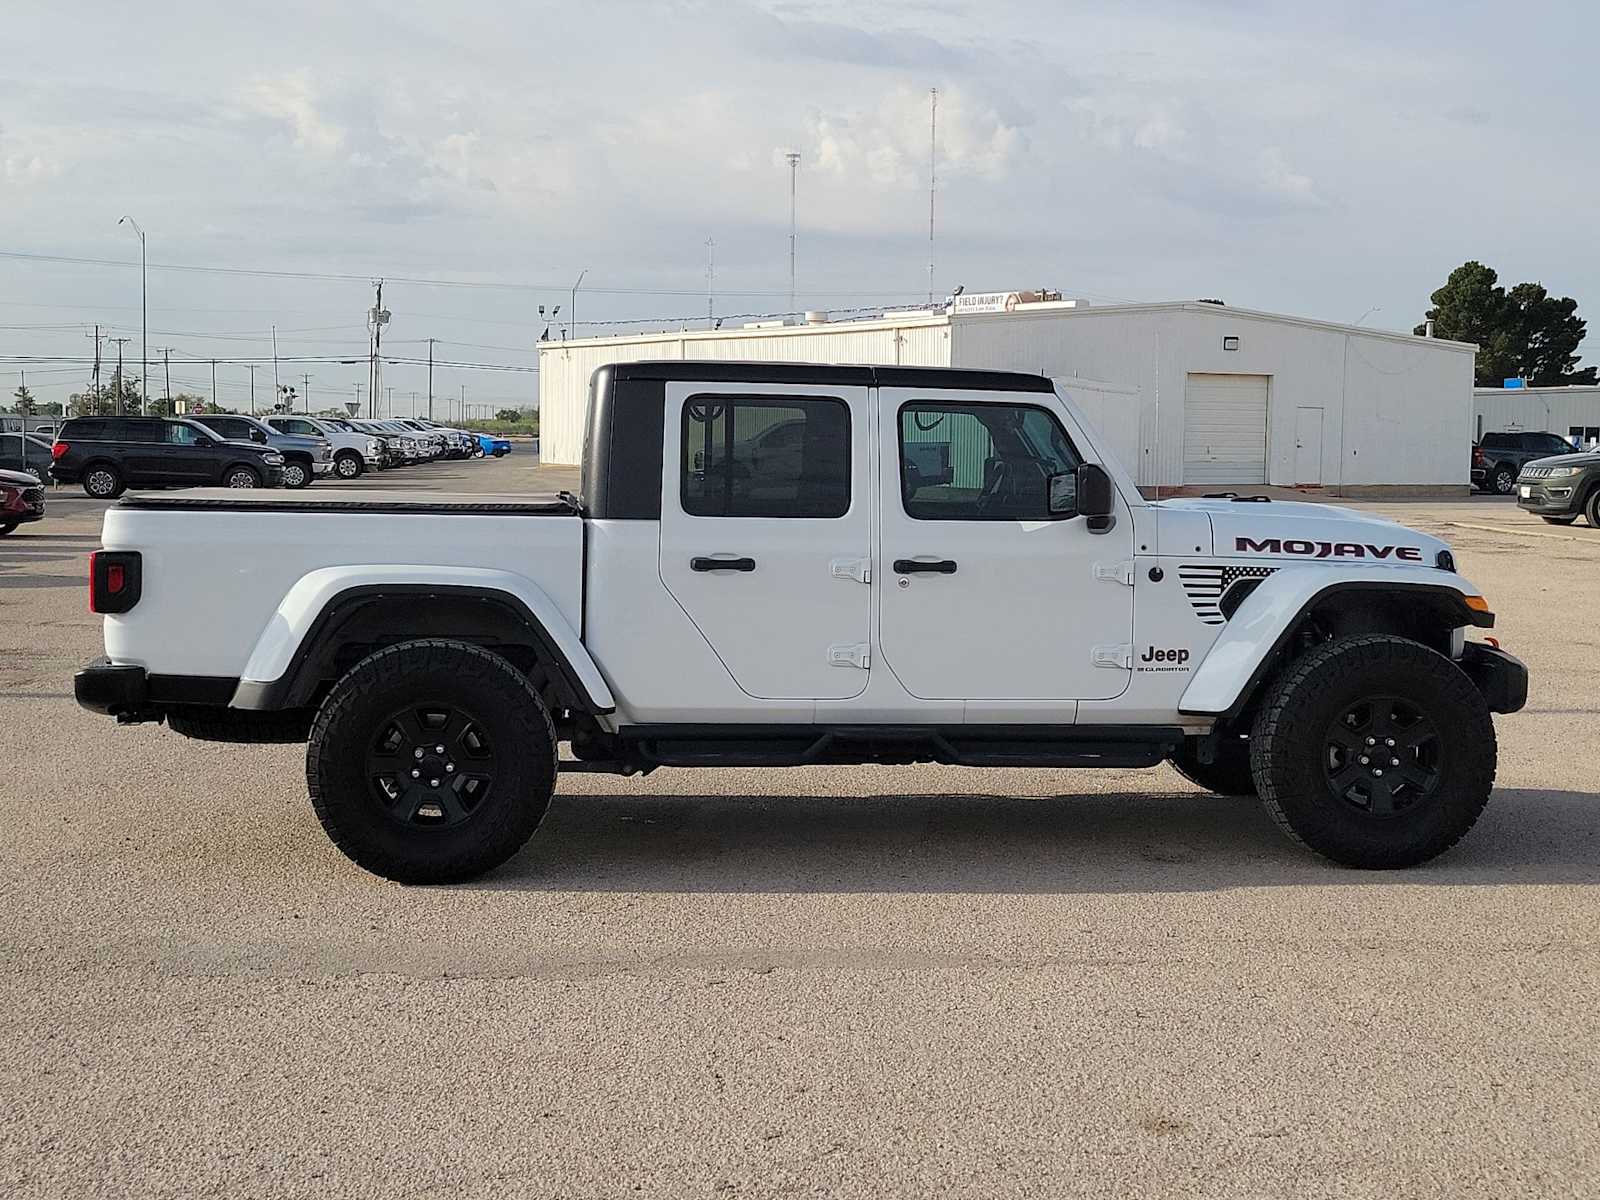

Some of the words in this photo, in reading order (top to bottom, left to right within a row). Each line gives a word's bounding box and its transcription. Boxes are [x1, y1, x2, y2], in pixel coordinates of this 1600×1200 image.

[959, 297, 976, 306] FIELD
[977, 295, 1004, 305] INJURY?
[1235, 537, 1422, 561] MOJAVE
[1141, 646, 1189, 664] Jeep
